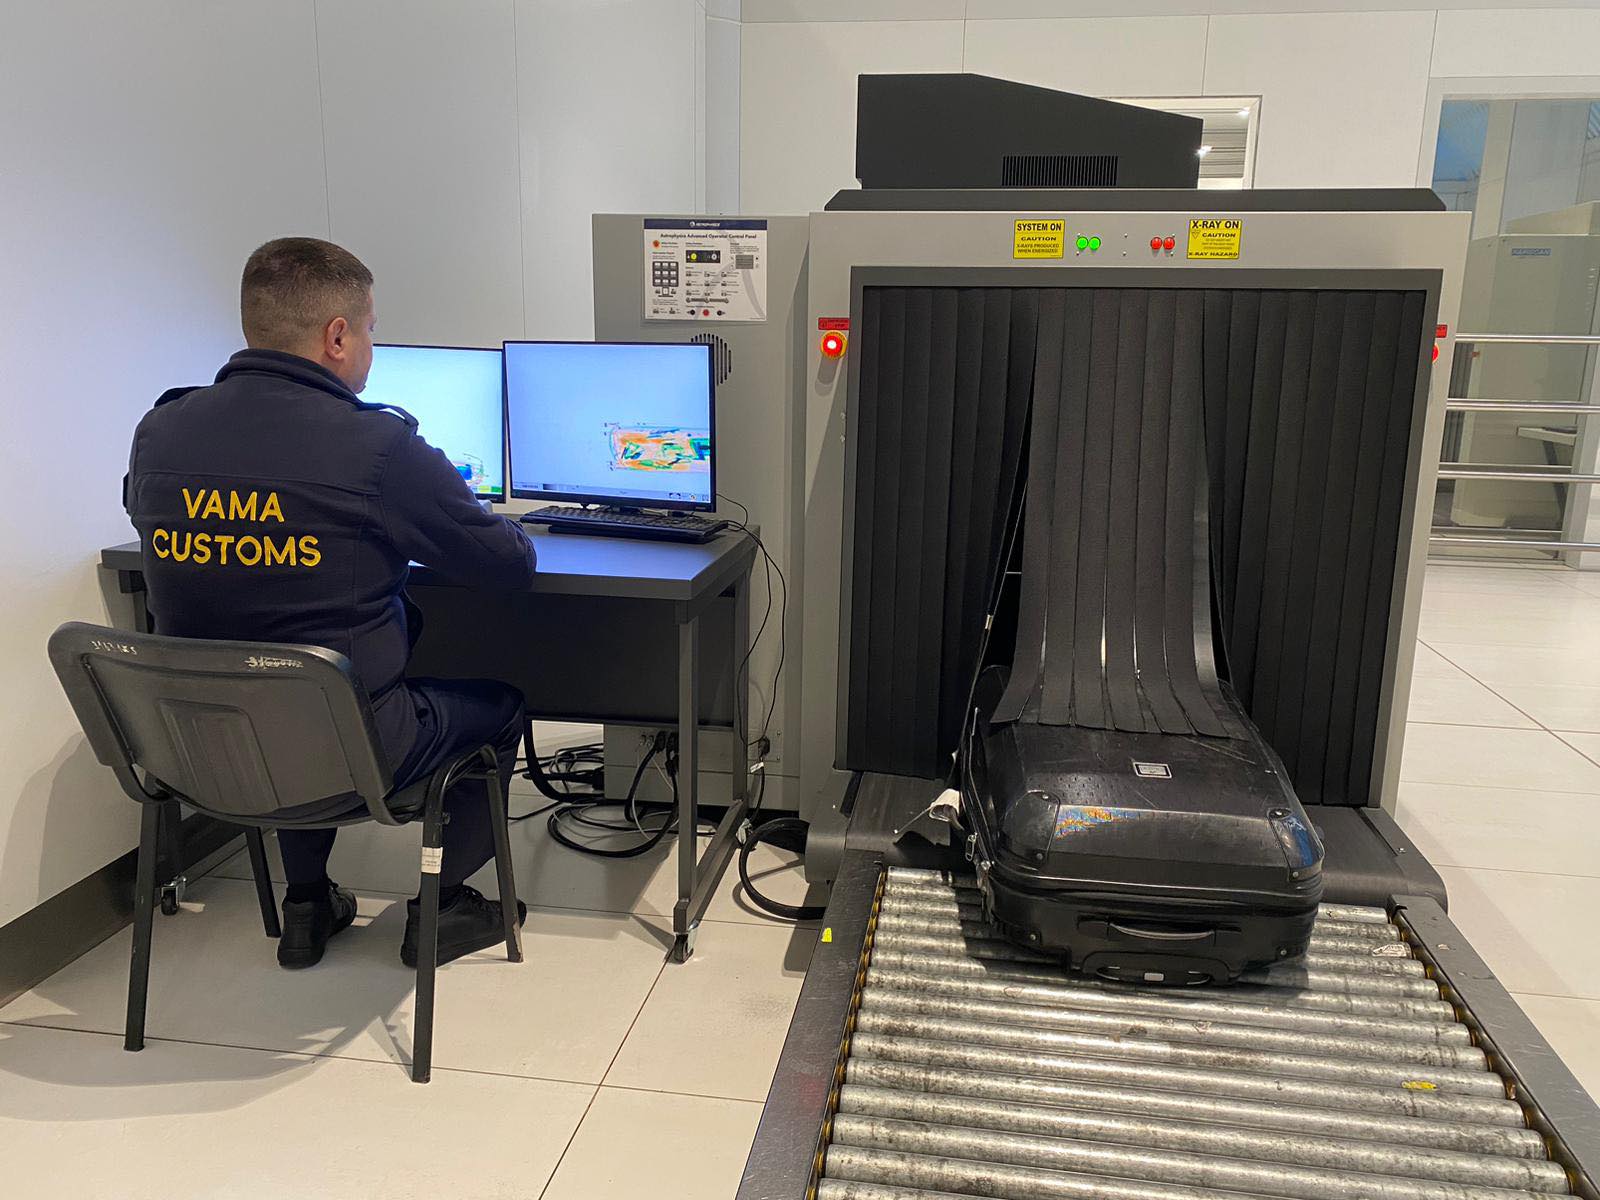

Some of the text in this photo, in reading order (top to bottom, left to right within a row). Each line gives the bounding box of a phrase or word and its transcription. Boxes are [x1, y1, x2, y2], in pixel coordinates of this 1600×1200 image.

[1017, 223, 1062, 231] SYSTEM ON
[1192, 220, 1239, 229] X-RAY ON
[182, 488, 285, 522] VAMA
[153, 528, 321, 567] CUSTOMS
